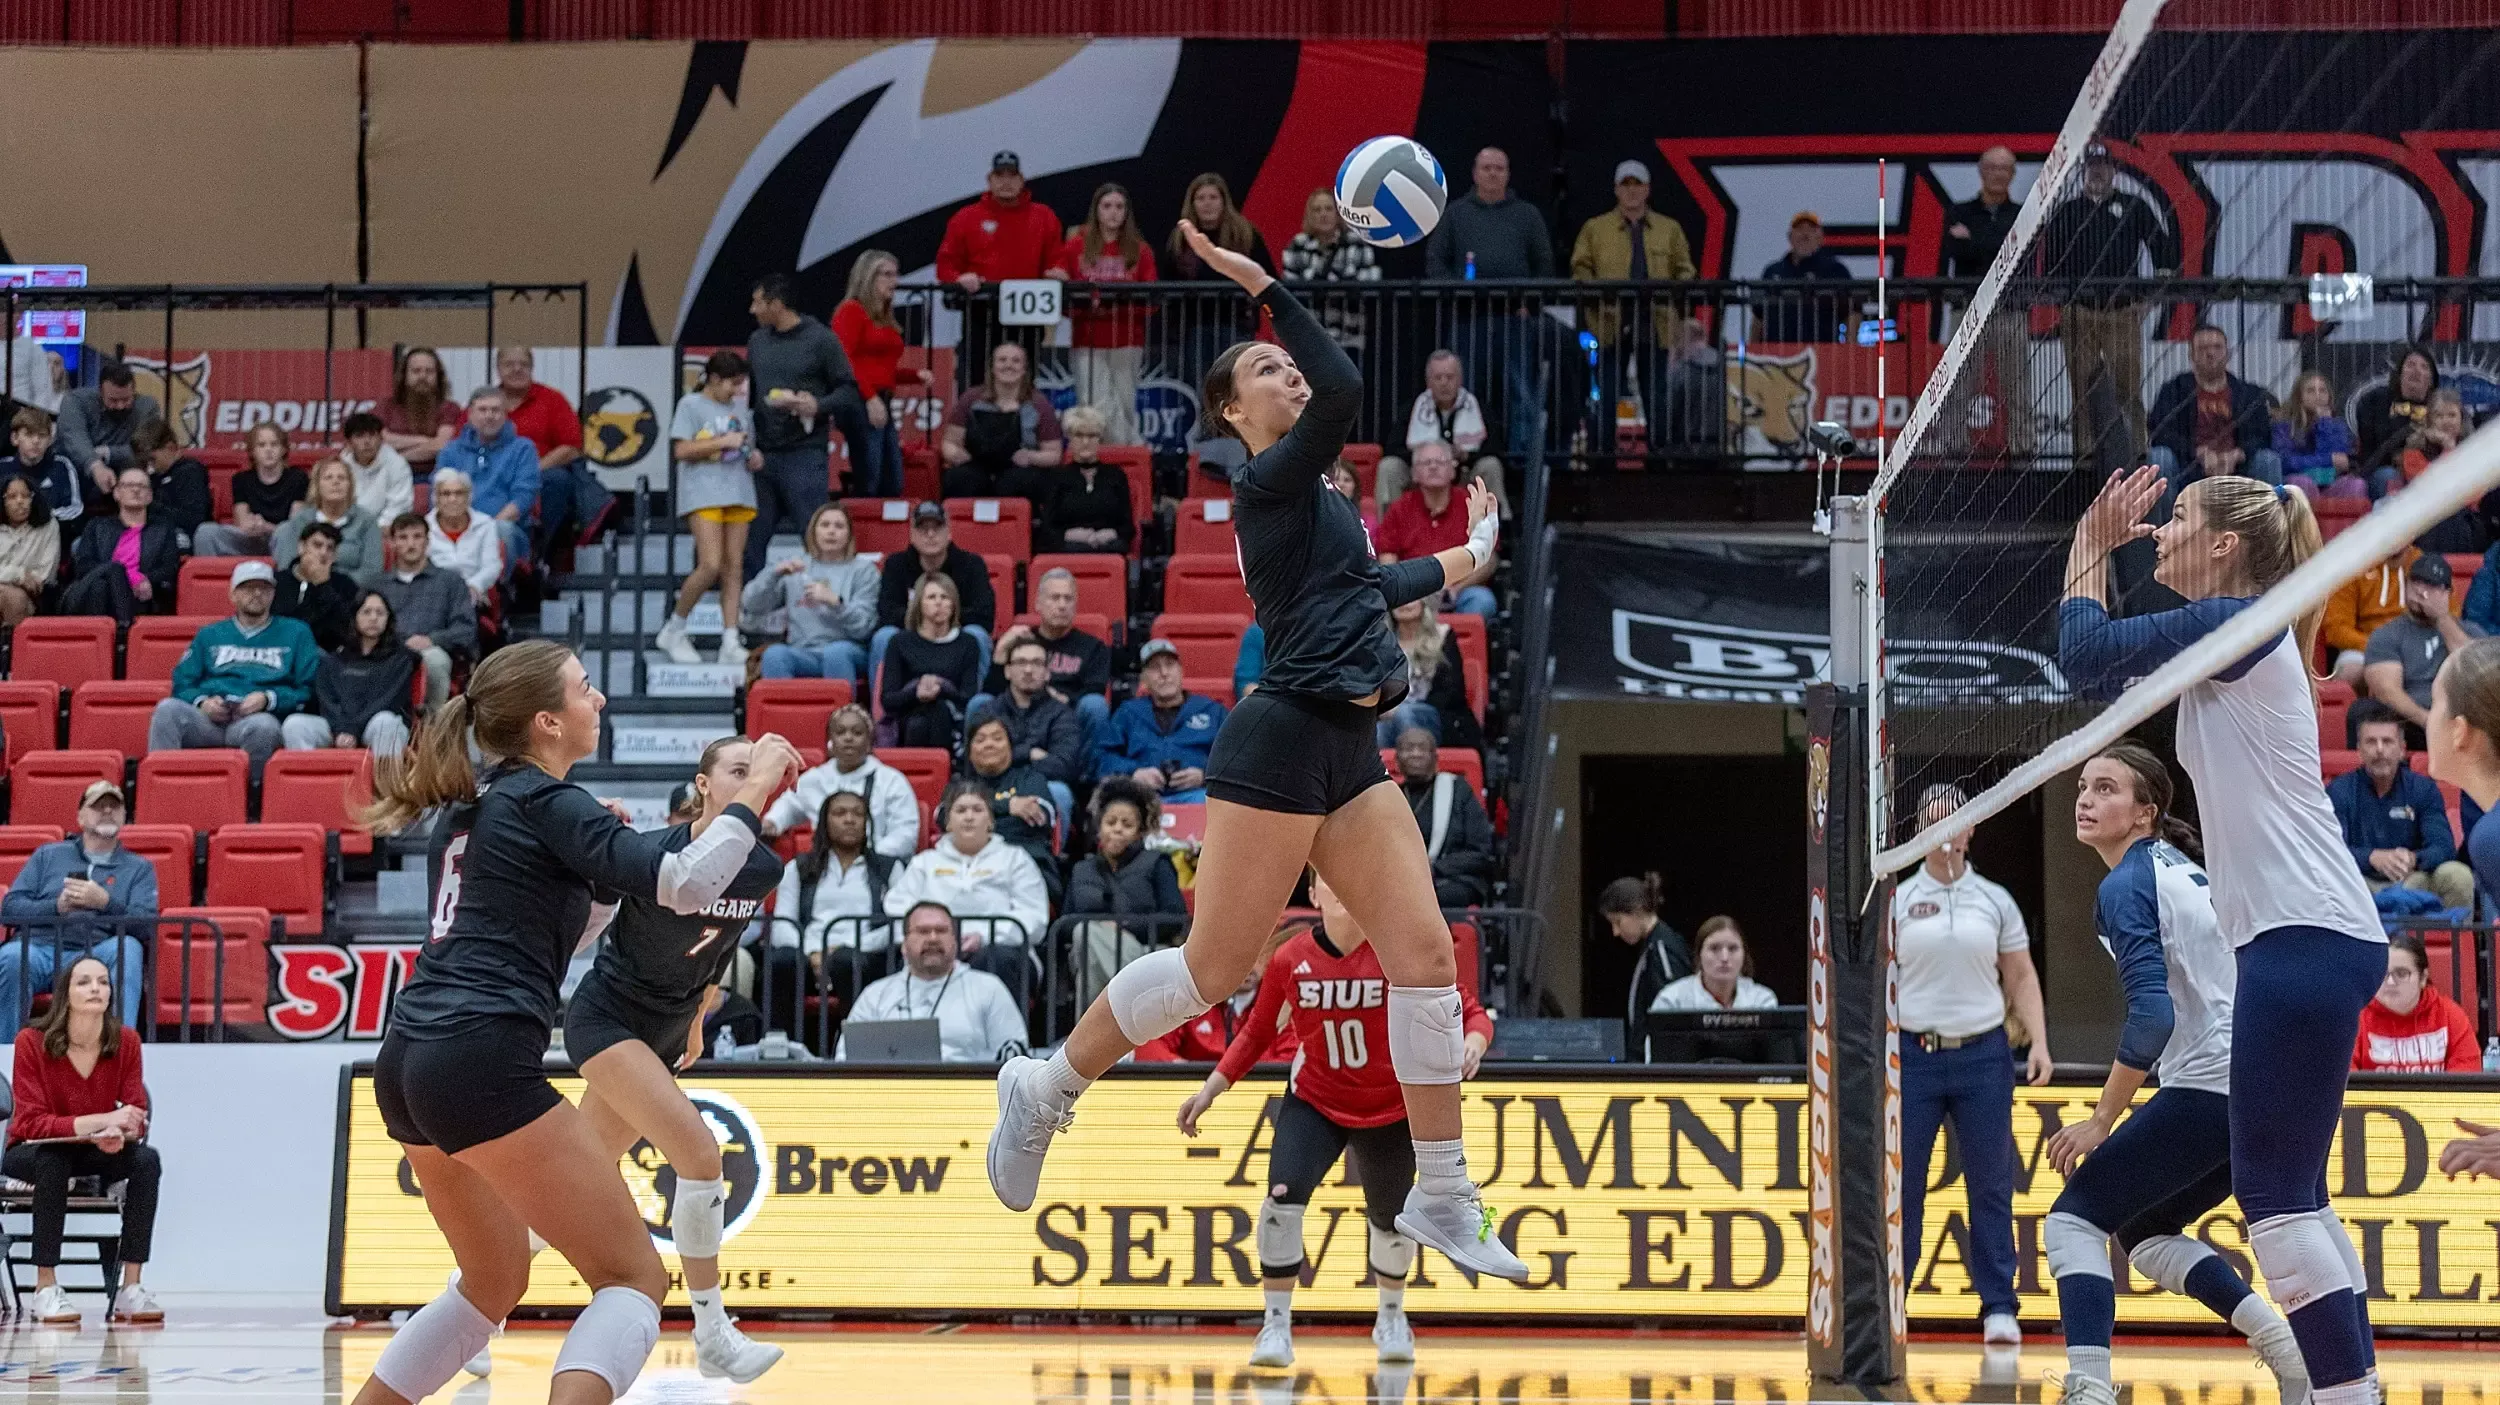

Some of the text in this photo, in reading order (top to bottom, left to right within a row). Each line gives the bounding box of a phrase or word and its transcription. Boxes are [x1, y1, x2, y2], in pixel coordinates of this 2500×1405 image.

[1005, 290, 1056, 315] 103
[430, 832, 469, 942] 6
[699, 898, 757, 919] UGARS
[684, 926, 722, 957] 7
[267, 943, 424, 1040] SI
[1298, 978, 1384, 1010] SIUE
[1322, 1019, 1368, 1070] 10
[1809, 892, 1834, 1342] COUGARS
[776, 1144, 951, 1196] Brew
[1033, 1202, 1577, 1291] SERVG
[668, 1270, 772, 1291] HUSE
